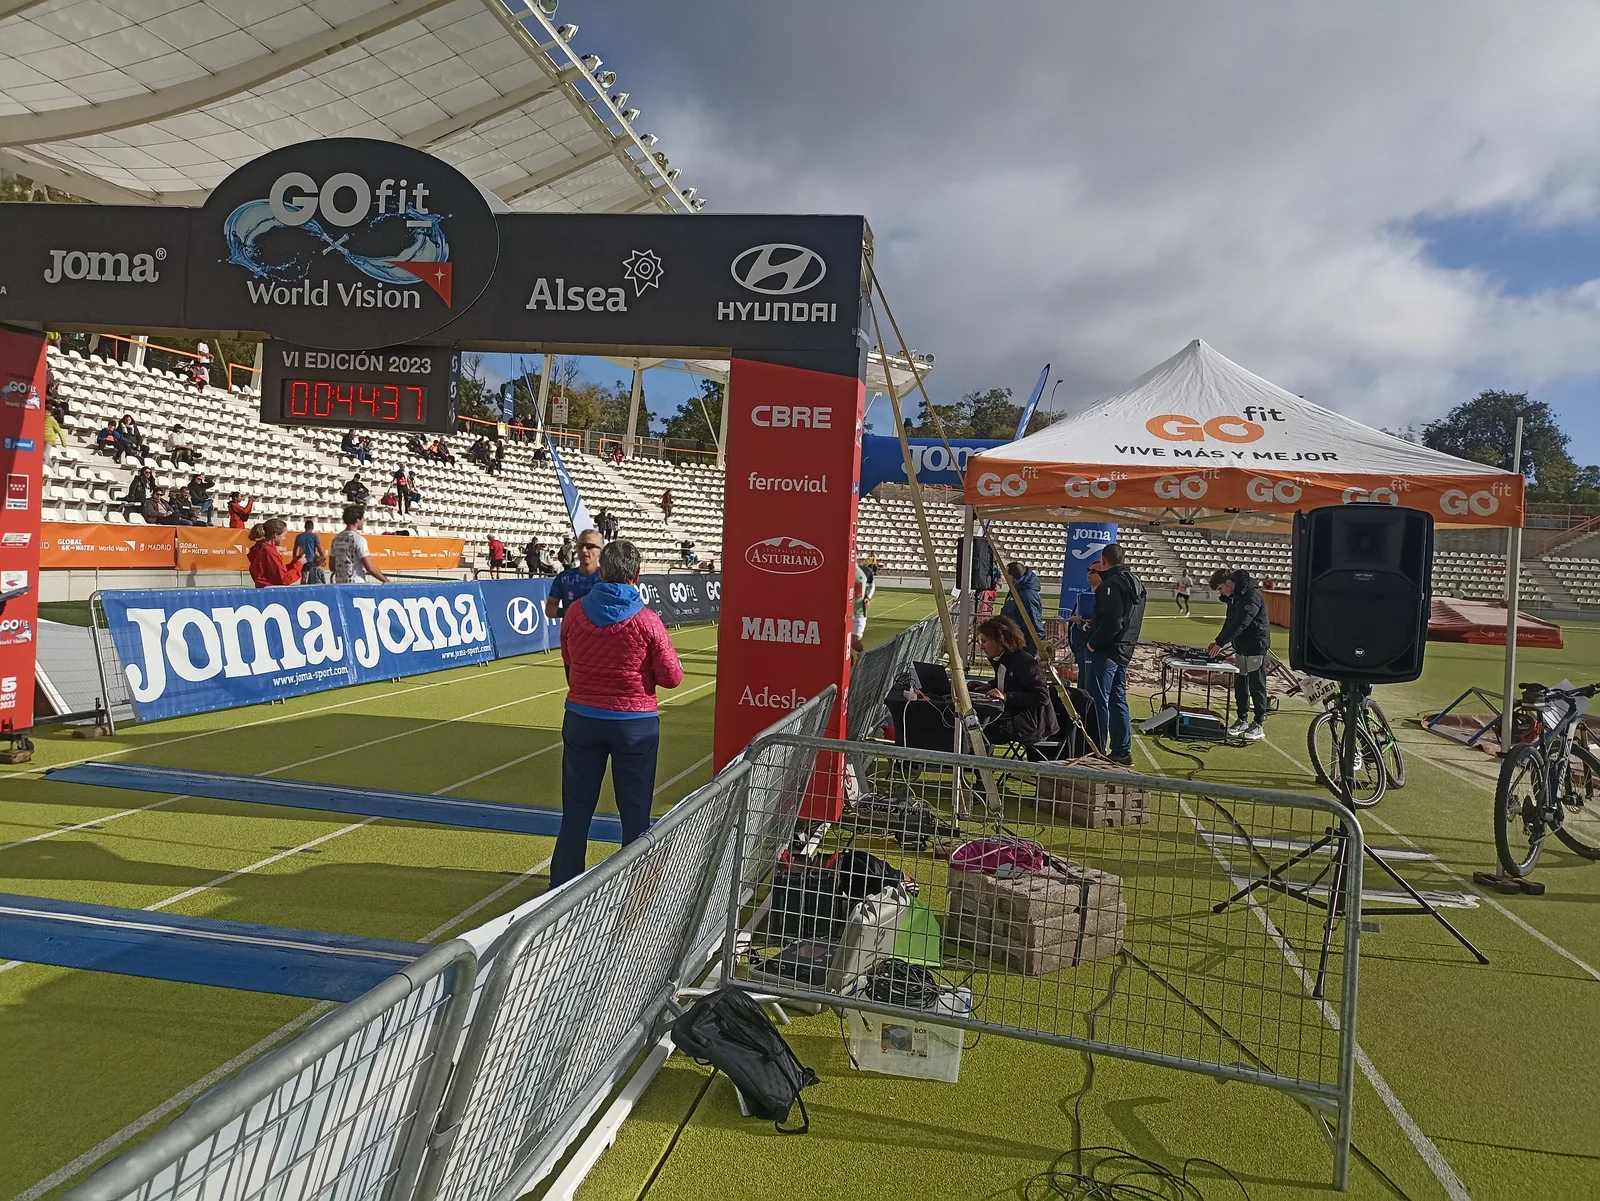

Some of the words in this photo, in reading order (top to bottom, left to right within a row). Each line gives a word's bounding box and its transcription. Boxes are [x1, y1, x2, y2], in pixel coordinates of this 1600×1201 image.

[247, 279, 329, 306] World
[337, 282, 421, 309] Vision
[525, 277, 628, 312] Alsea
[717, 301, 837, 322] HYUNDAI
[282, 351, 299, 367] VI
[304, 350, 383, 372] EDICIÓN
[388, 356, 432, 374] 2023
[291, 381, 423, 421] 00:44:37
[750, 405, 833, 429] CBRE
[1115, 444, 1167, 457] VIVE
[1173, 447, 1225, 459] MÁS
[1228, 450, 1243, 460] Y
[1252, 451, 1339, 462] MEJOR
[748, 471, 828, 494] ferrovial
[1072, 528, 1112, 541] Joma
[751, 548, 818, 566] ASTURIANA
[352, 593, 487, 669] Joma
[741, 616, 821, 645] MARCA
[125, 600, 344, 703] Joma
[1, 676, 18, 693] 5
[272, 665, 349, 687] www.joma-sport.com
[0, 692, 16, 702] NOV
[738, 684, 808, 710] Adesla
[1308, 681, 1337, 703] MUJER
